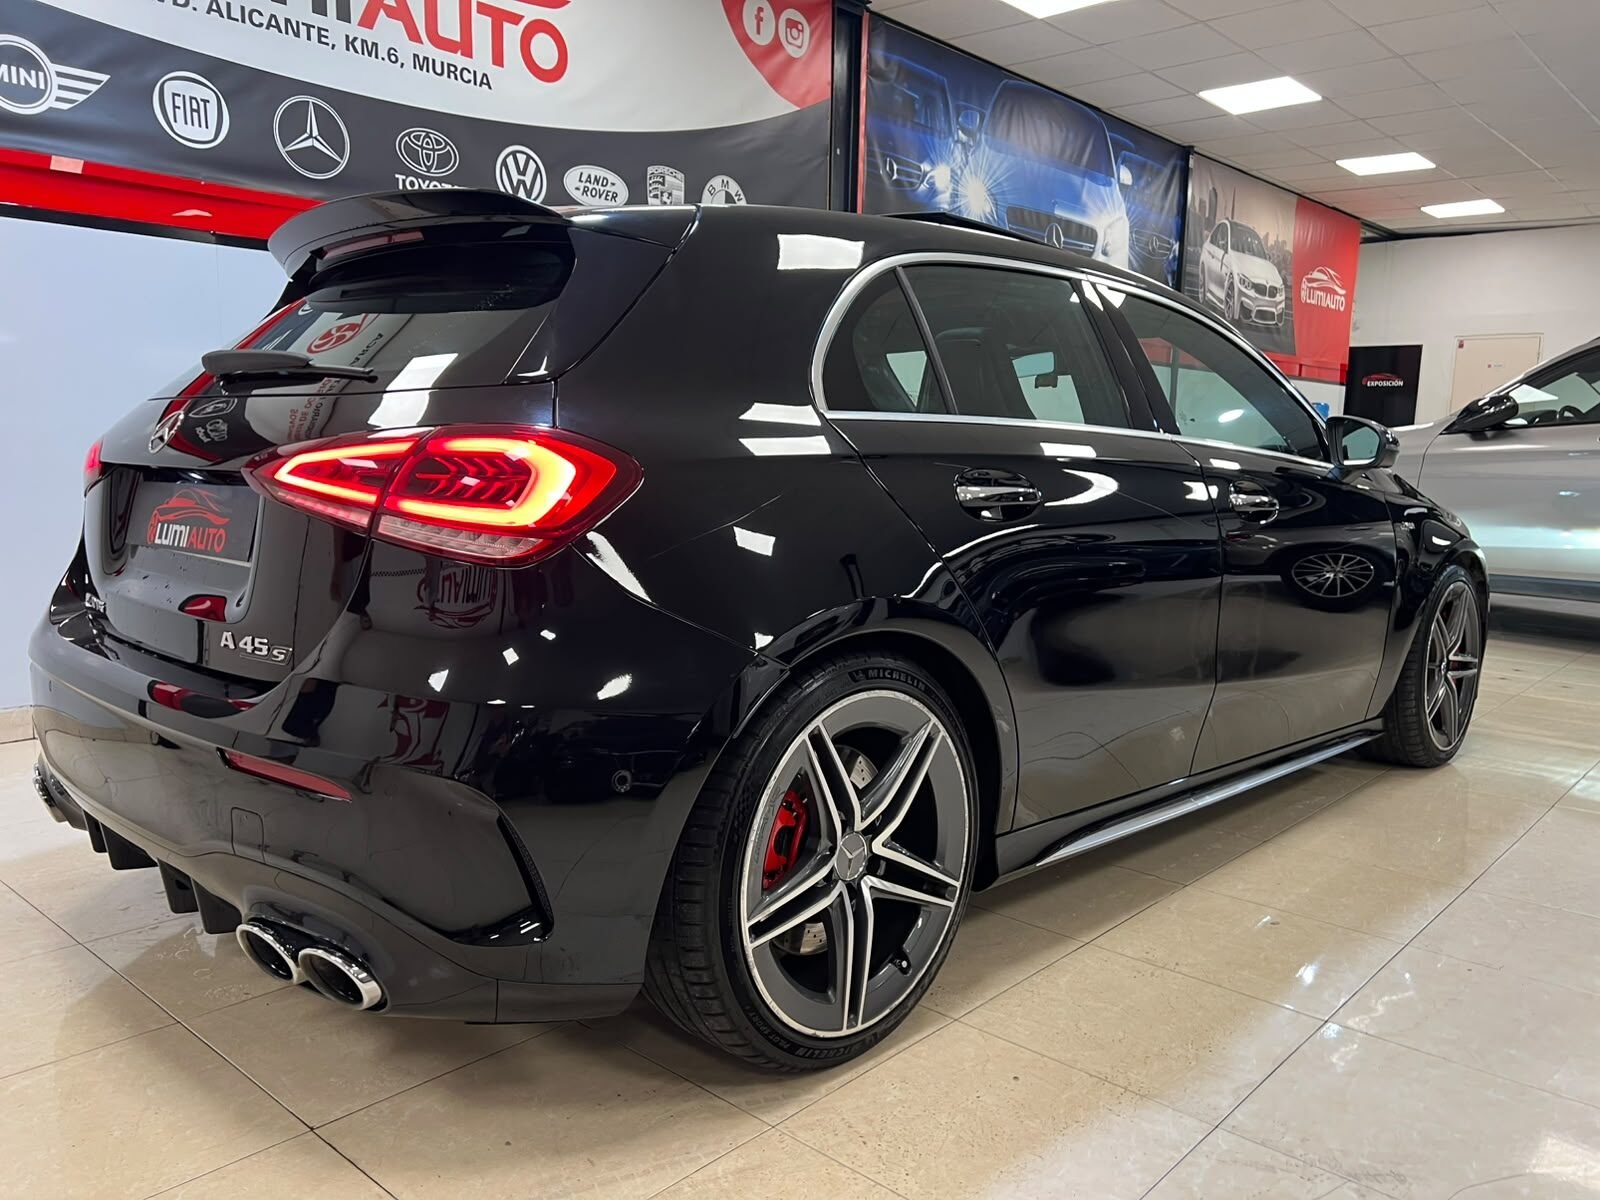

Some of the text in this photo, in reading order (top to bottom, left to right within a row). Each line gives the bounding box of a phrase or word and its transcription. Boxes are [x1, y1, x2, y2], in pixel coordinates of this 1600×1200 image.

[206, 0, 493, 90] ALICANTE, KM.6, MURCIA
[271, 0, 568, 83] AUTO
[171, 91, 210, 129] FIAT
[395, 174, 463, 190] TOY
[707, 179, 743, 202] BMW
[1306, 287, 1345, 311] LUMIAUTO
[154, 522, 226, 553] LUMIAUTO
[220, 631, 235, 650] A
[238, 635, 269, 656] 45
[868, 668, 926, 691] MICHELIN
